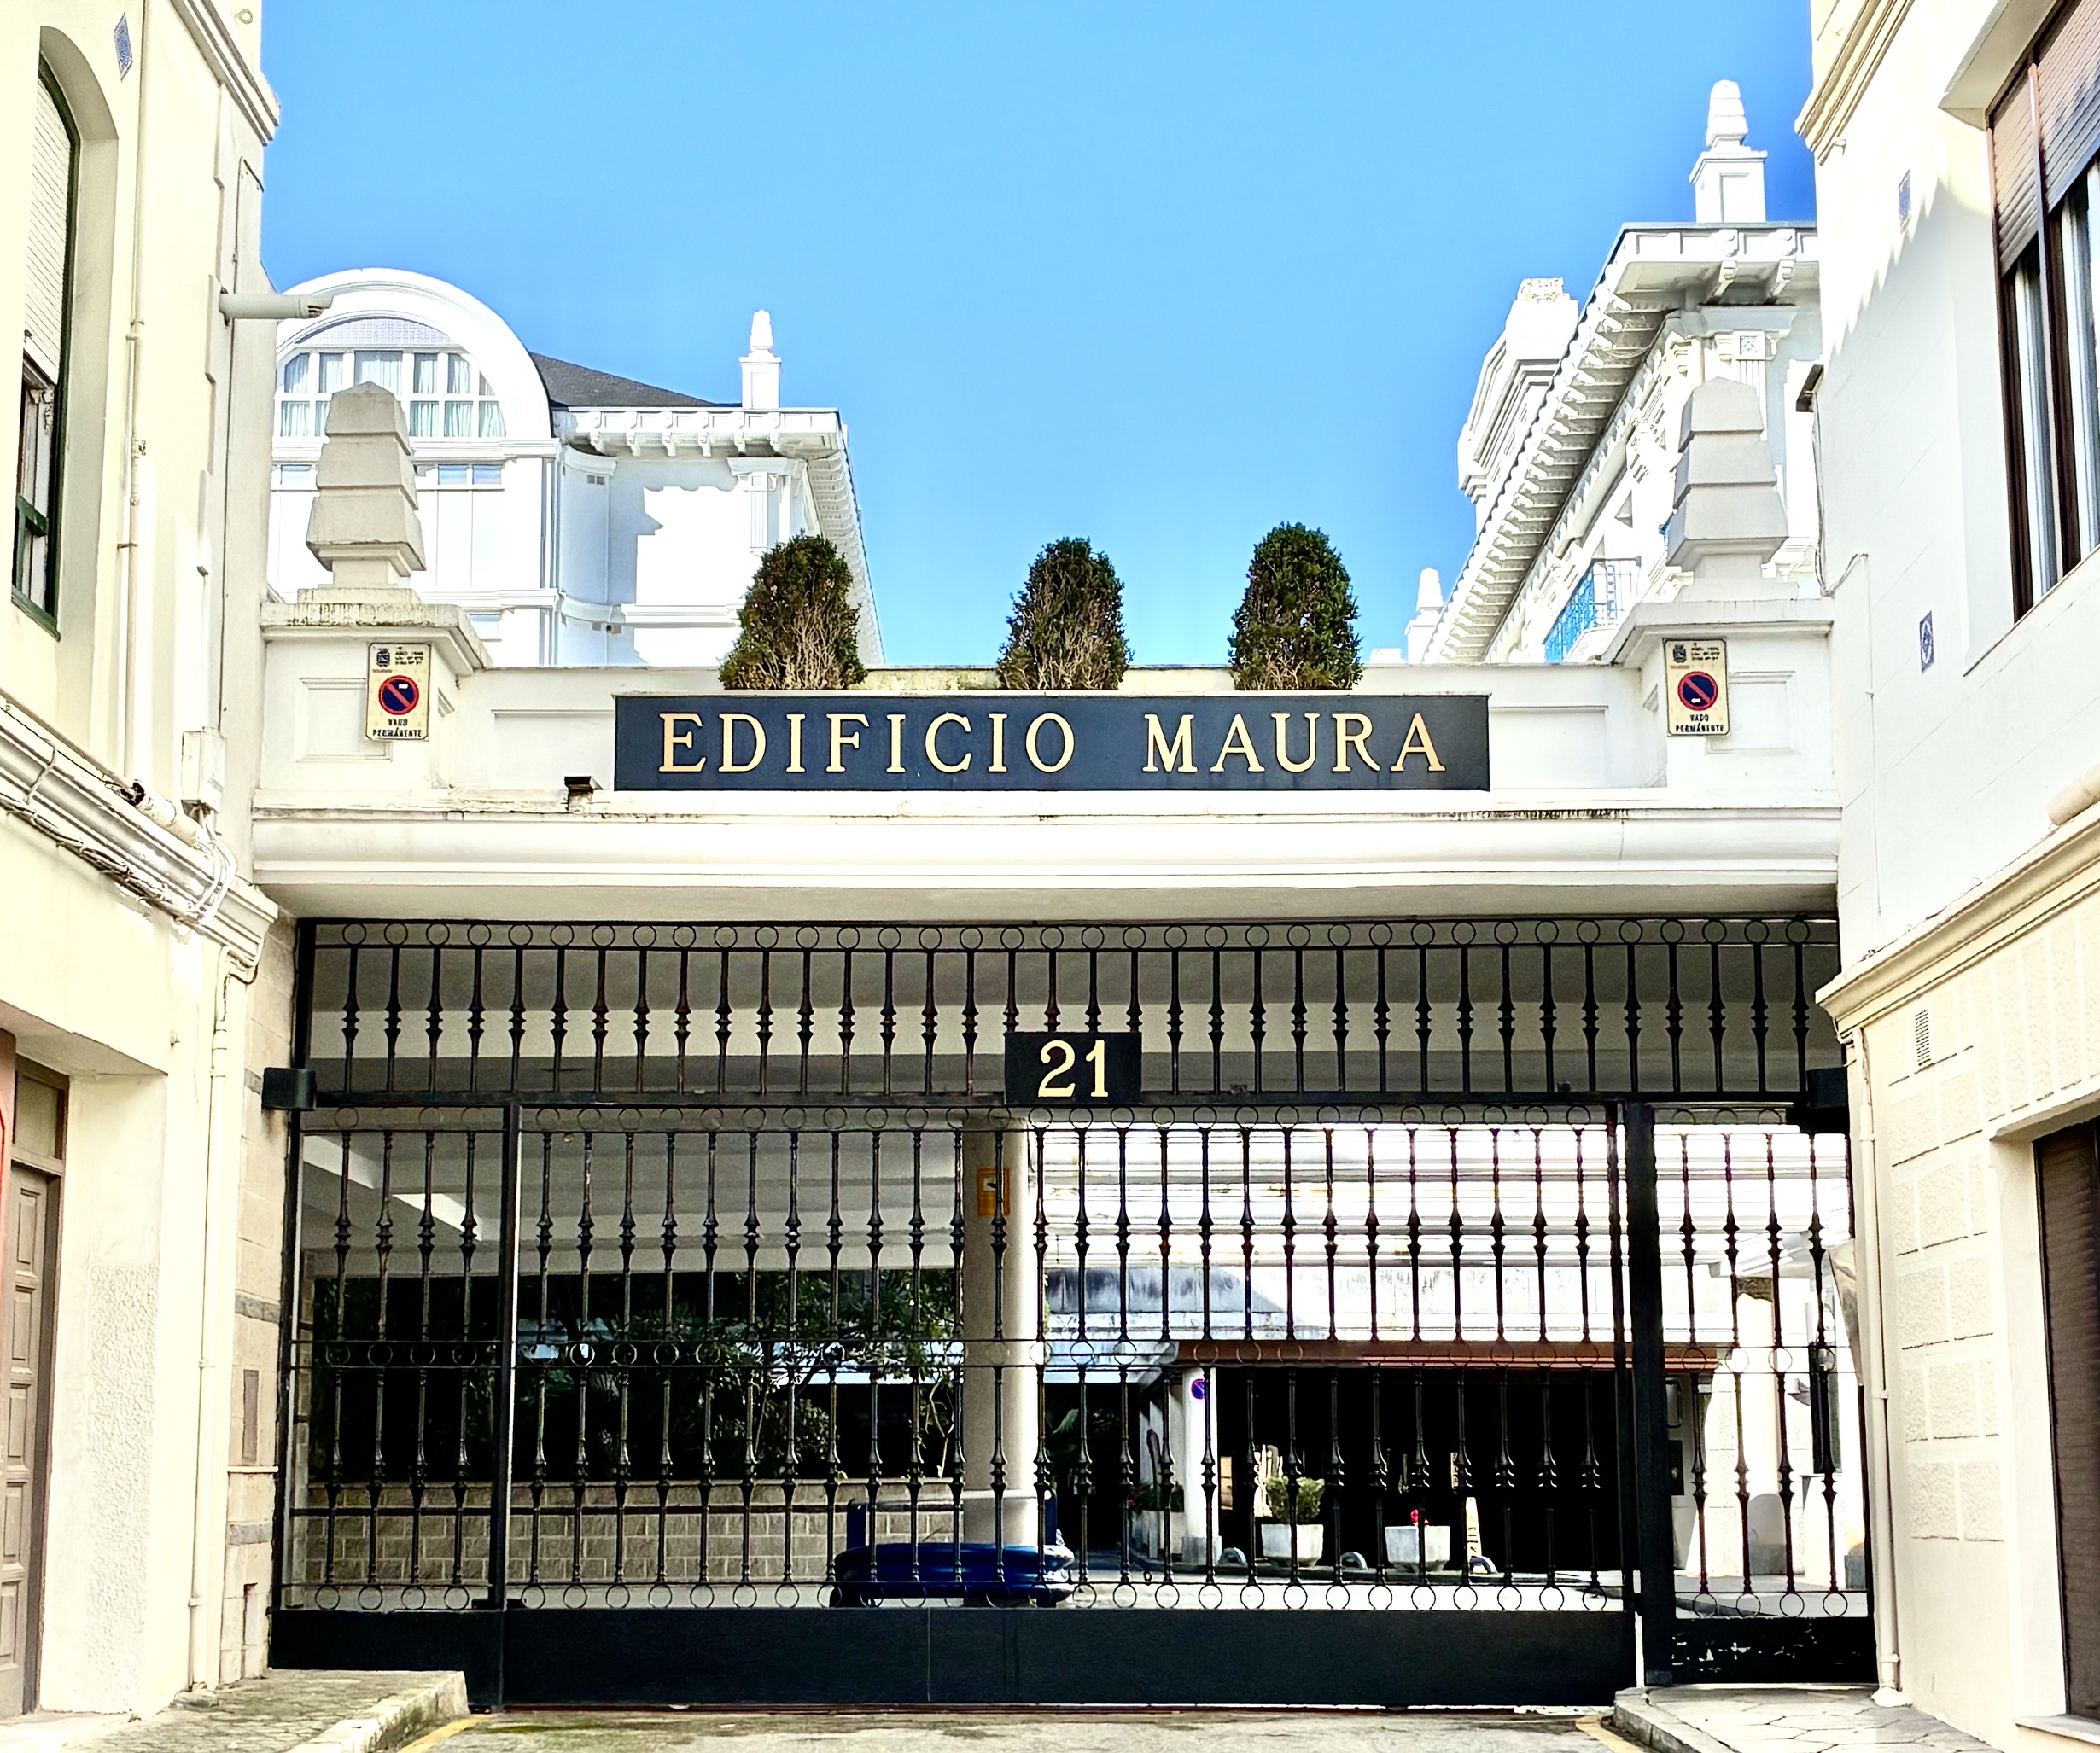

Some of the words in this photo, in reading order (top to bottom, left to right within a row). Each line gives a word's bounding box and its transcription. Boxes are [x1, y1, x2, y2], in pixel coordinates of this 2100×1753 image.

[658, 713, 1075, 772] EDIFICIO
[1141, 713, 1446, 773] MAURA
[1038, 1040, 1108, 1098] 21
